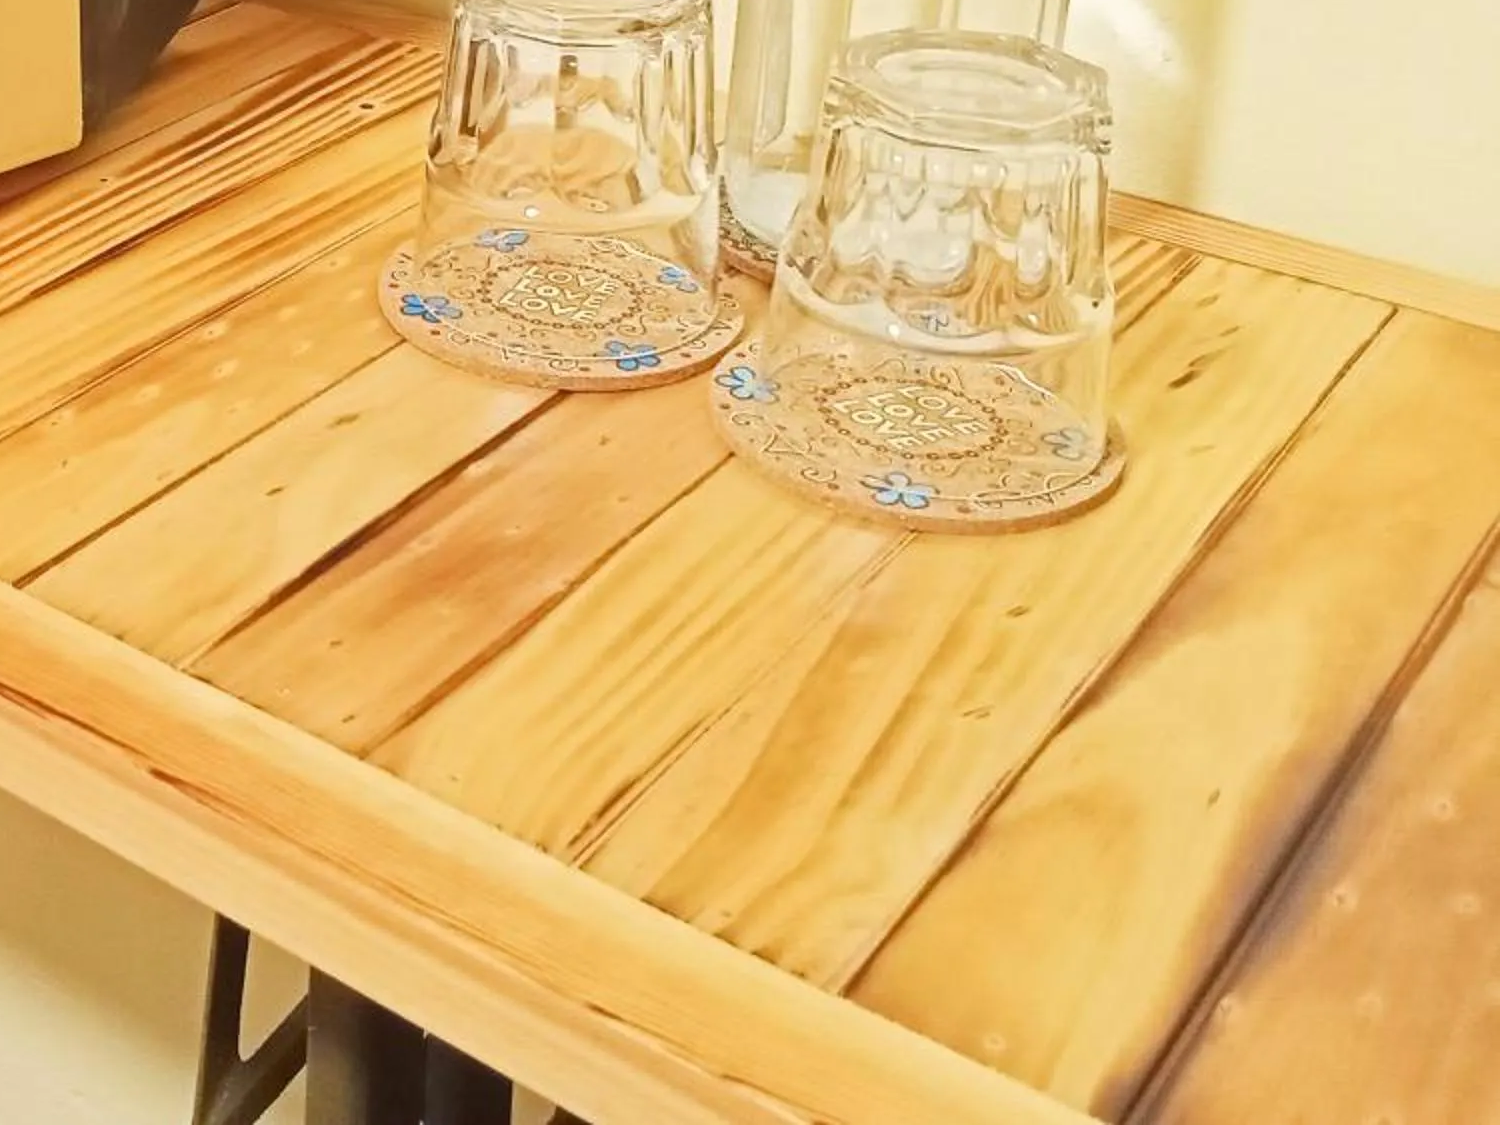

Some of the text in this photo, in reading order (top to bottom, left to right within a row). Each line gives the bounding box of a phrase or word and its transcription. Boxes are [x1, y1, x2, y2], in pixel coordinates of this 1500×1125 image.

[513, 278, 607, 309] LOVE
[522, 266, 619, 295] LOVE
[500, 291, 597, 323] LOVE
[833, 400, 924, 450] LOVE
[867, 393, 954, 442] LOVE
[897, 386, 988, 435] LOVE
